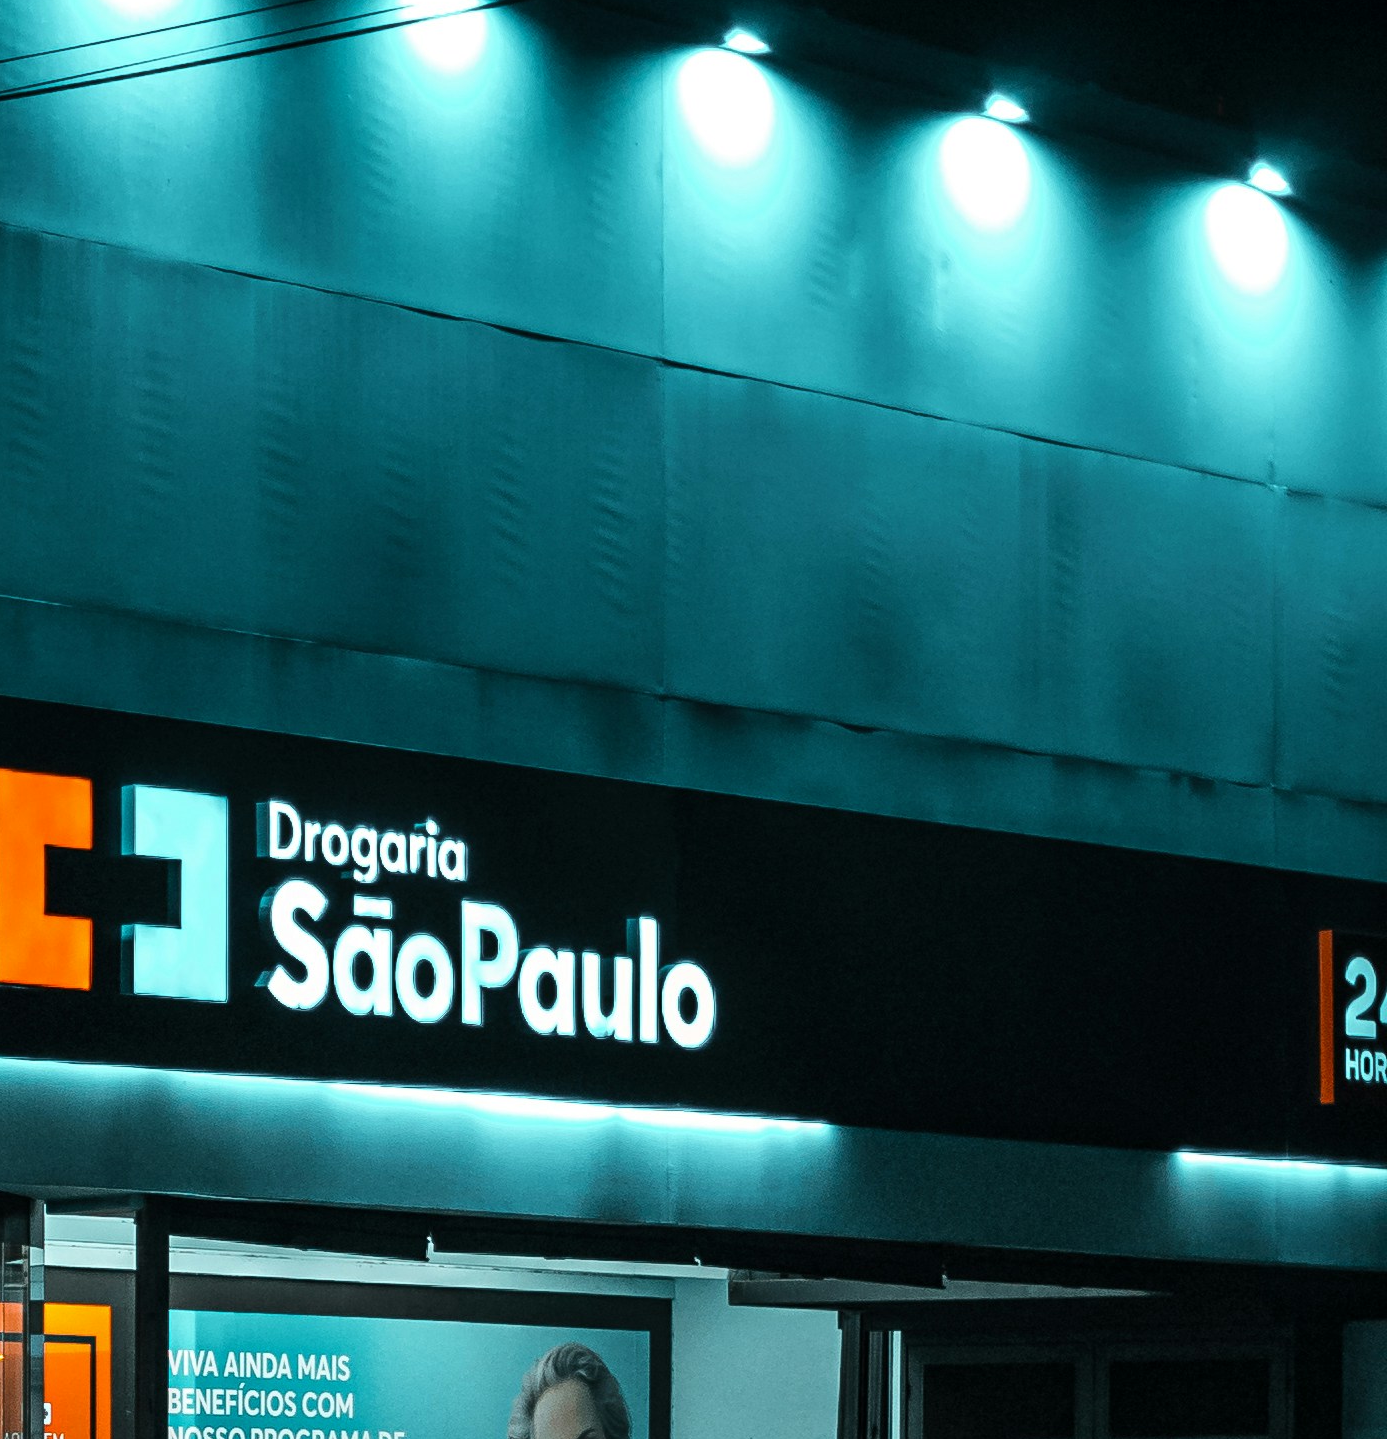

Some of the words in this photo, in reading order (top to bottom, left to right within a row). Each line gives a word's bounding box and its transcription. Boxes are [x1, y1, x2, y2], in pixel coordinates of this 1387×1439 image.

[268, 797, 469, 883] Drogaria
[266, 877, 716, 1050] SãoPaulo
[1345, 957, 1387, 1040] 2
[1345, 1047, 1387, 1084] HOR
[168, 1349, 219, 1377] VIVA
[223, 1351, 293, 1380] AINDA
[297, 1353, 351, 1382] MAIS
[167, 1382, 297, 1418] BENEFÍCIOS
[301, 1391, 355, 1419] COM
